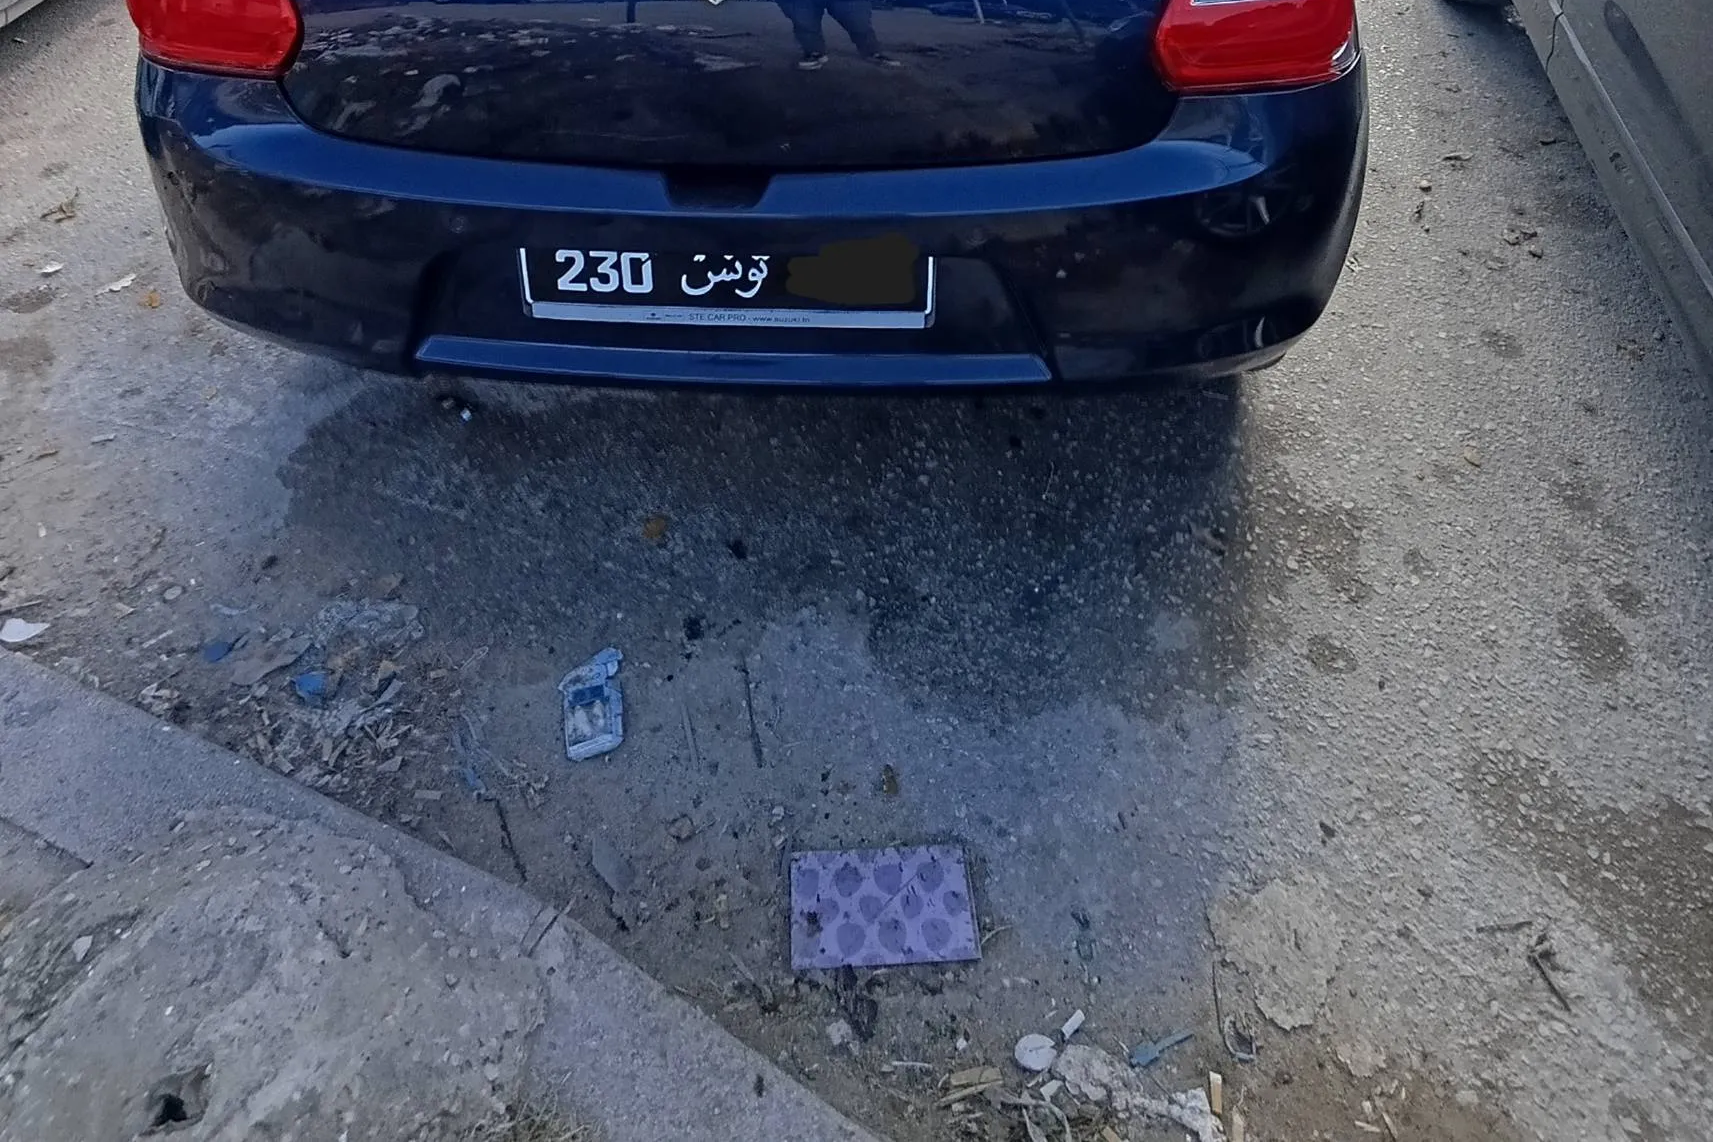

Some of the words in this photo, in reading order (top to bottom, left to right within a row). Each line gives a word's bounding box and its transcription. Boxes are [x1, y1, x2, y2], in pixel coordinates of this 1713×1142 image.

[555, 249, 654, 294] 230
[681, 254, 771, 298] تونس
[688, 313, 705, 321] STE
[708, 313, 726, 322] CAR
[727, 314, 746, 322] PRO
